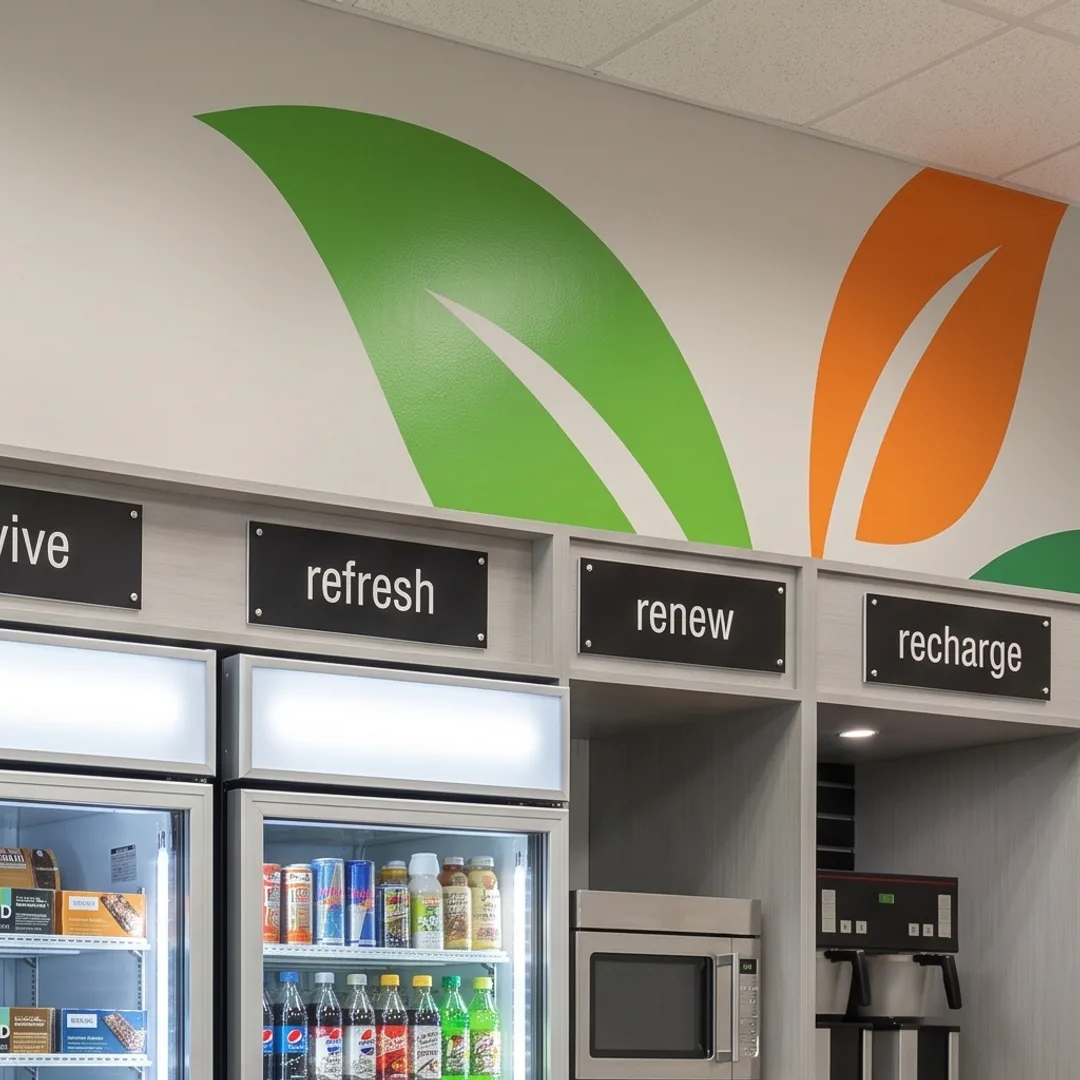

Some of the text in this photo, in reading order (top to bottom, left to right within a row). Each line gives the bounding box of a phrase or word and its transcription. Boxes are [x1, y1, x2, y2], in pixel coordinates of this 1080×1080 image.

[307, 560, 435, 615] refresh
[636, 598, 735, 641] renew
[898, 625, 1024, 678] recharge
